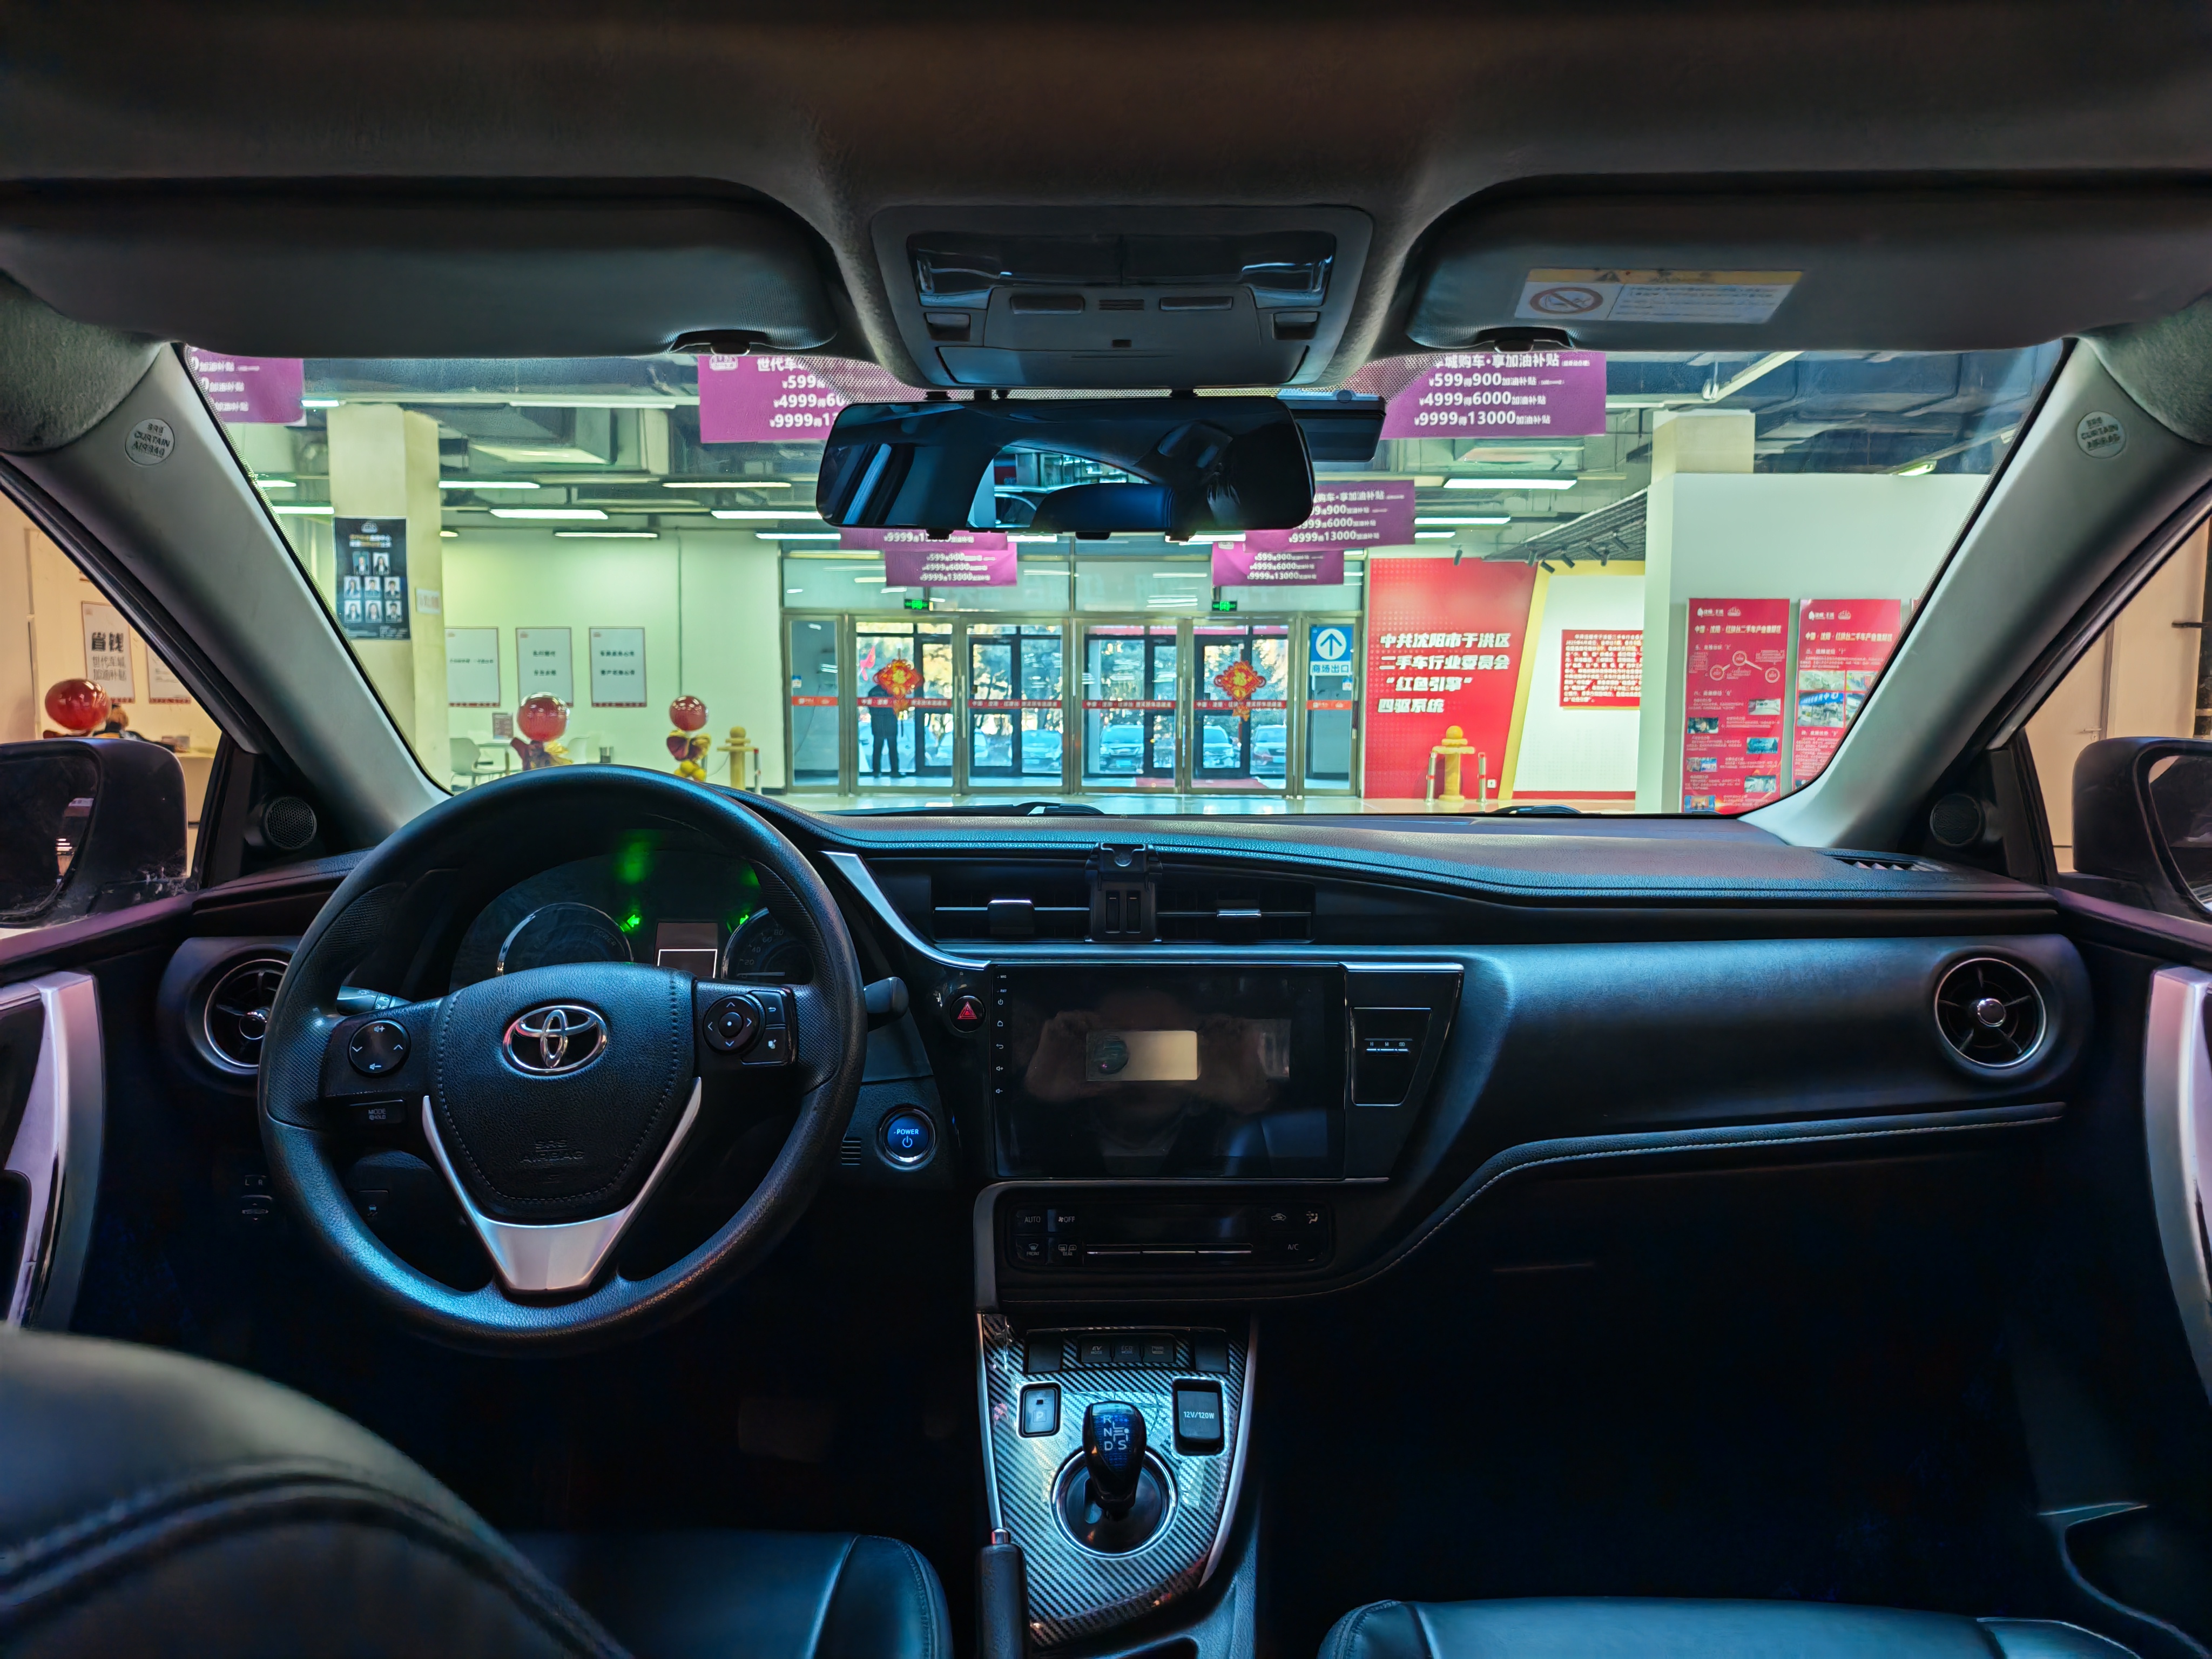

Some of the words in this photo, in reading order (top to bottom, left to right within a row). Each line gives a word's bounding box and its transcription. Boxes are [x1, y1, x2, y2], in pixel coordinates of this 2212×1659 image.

[1380, 632, 1511, 648] 中共沈阳市于洪区
[1379, 655, 1510, 670] 二手车行业委员会
[1312, 664, 1349, 673] 商场出口
[1103, 1414, 1112, 1424] R
[1183, 1411, 1215, 1419] 12V/120W
[1103, 1427, 1112, 1437] N
[1104, 1441, 1113, 1451] D
[1117, 1440, 1127, 1451] S
